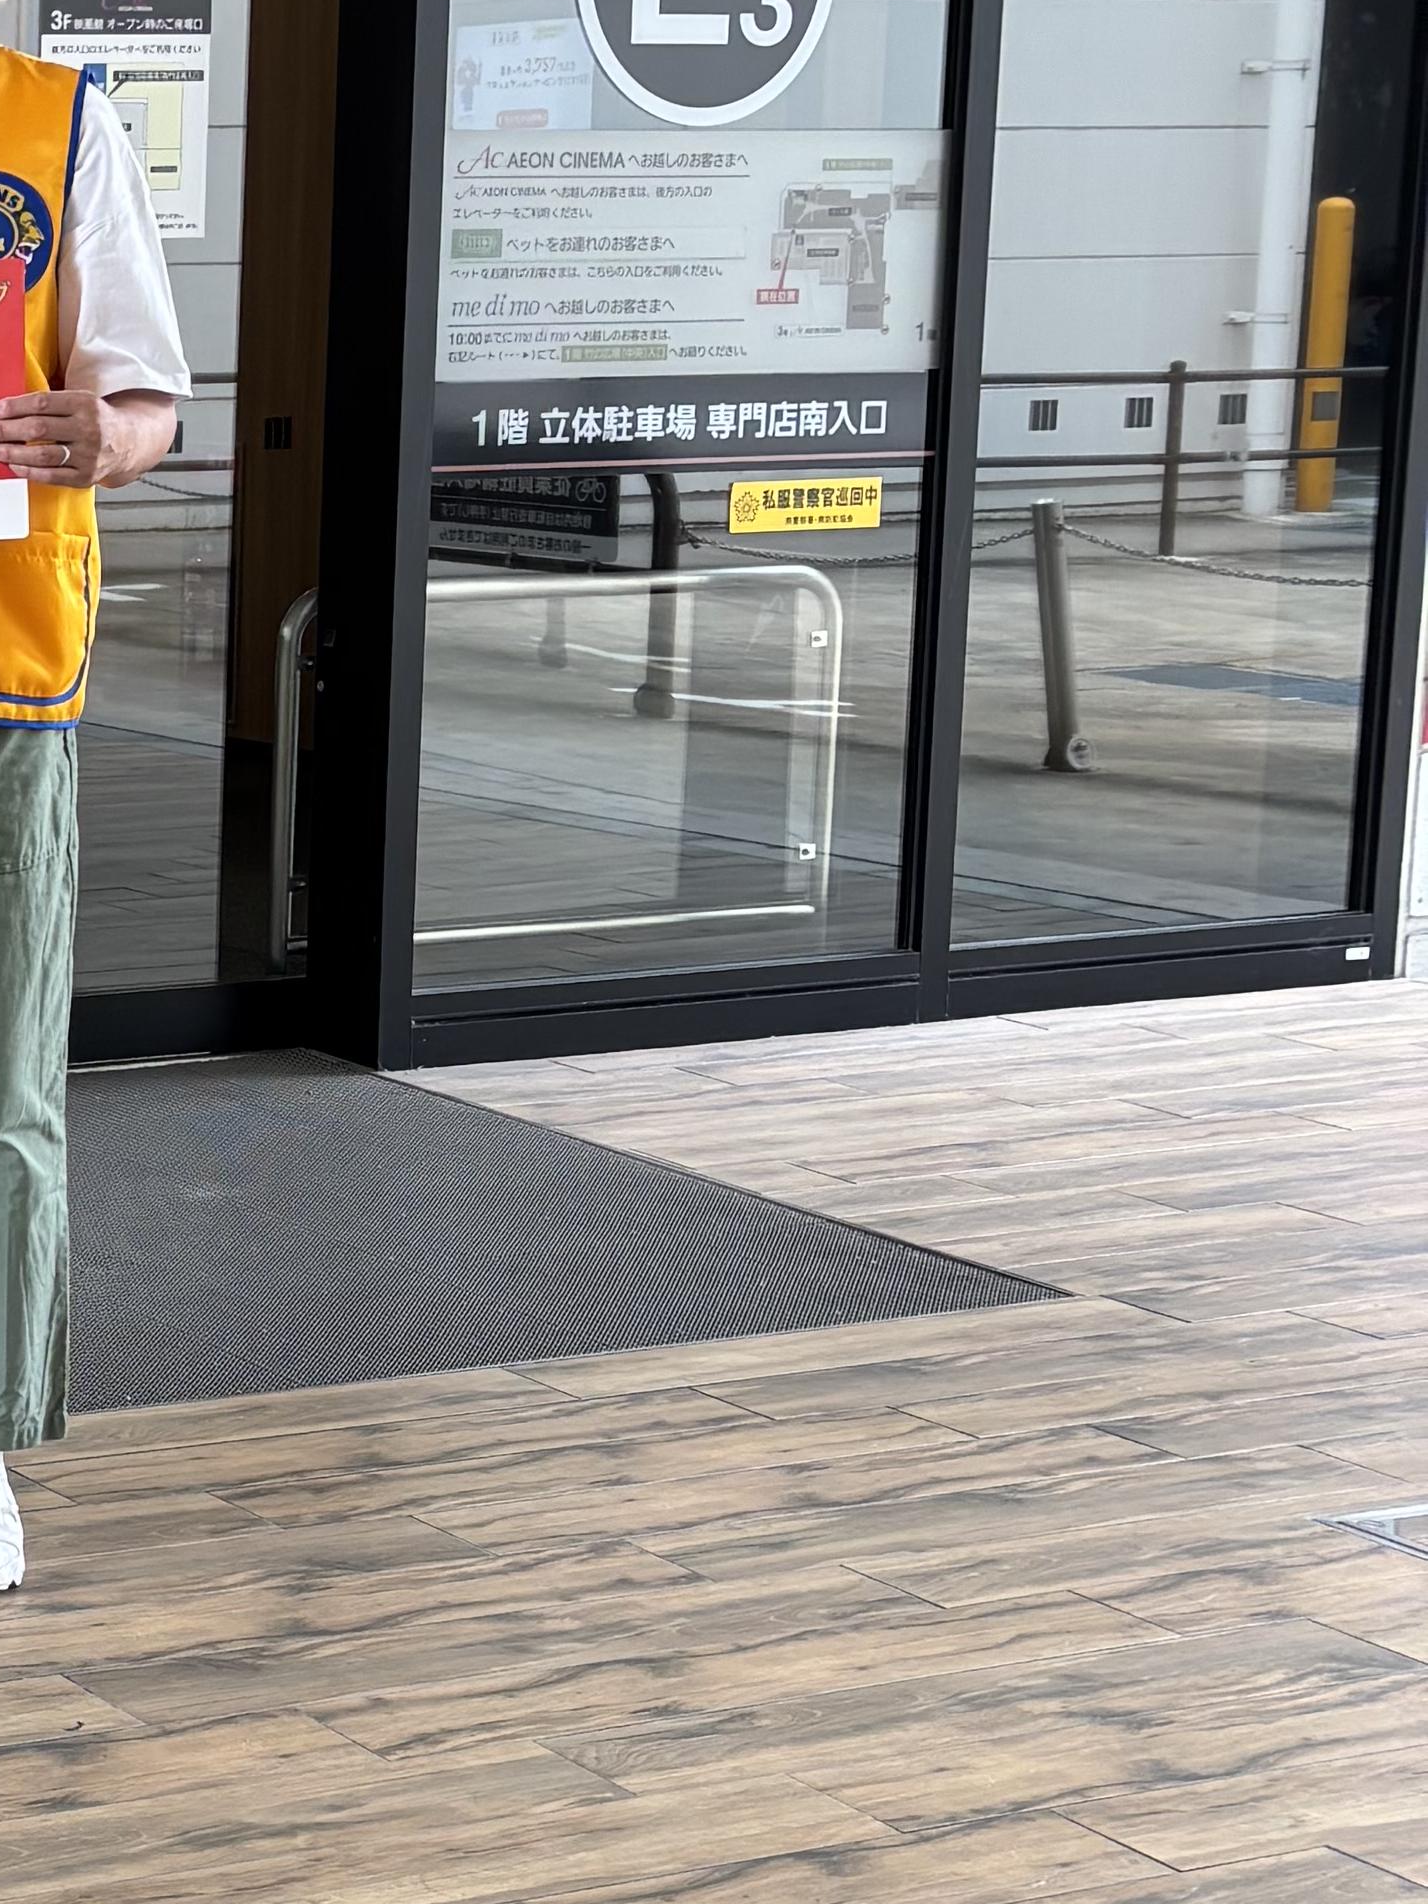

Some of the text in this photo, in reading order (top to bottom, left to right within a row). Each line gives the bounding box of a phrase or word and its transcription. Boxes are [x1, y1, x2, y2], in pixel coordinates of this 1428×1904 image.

[506, 152, 554, 169] AEON
[559, 151, 625, 169] CINEMA
[471, 399, 888, 447] 1階 立体駐車場 専門店南入口
